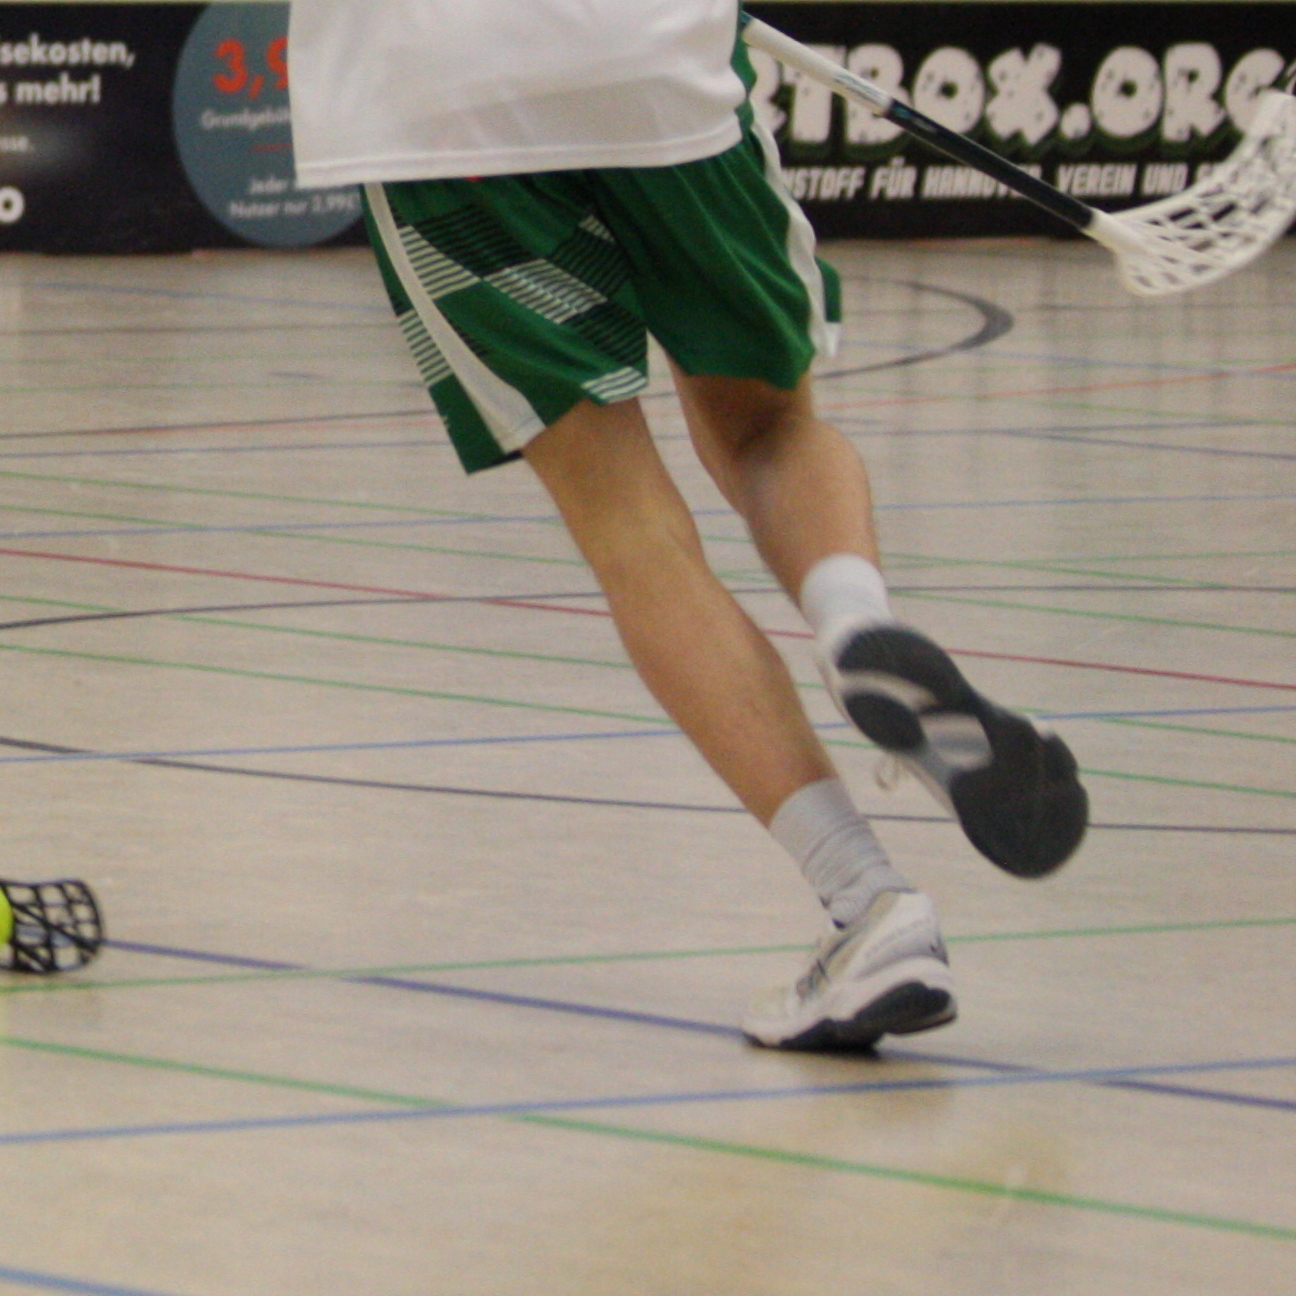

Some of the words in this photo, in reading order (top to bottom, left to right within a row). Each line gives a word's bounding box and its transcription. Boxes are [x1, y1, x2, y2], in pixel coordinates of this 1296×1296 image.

[15, 71, 102, 104] mehr!
[871, 156, 918, 200] FÜR
[1057, 163, 1137, 196] VEREIN
[1140, 162, 1189, 195] UND
